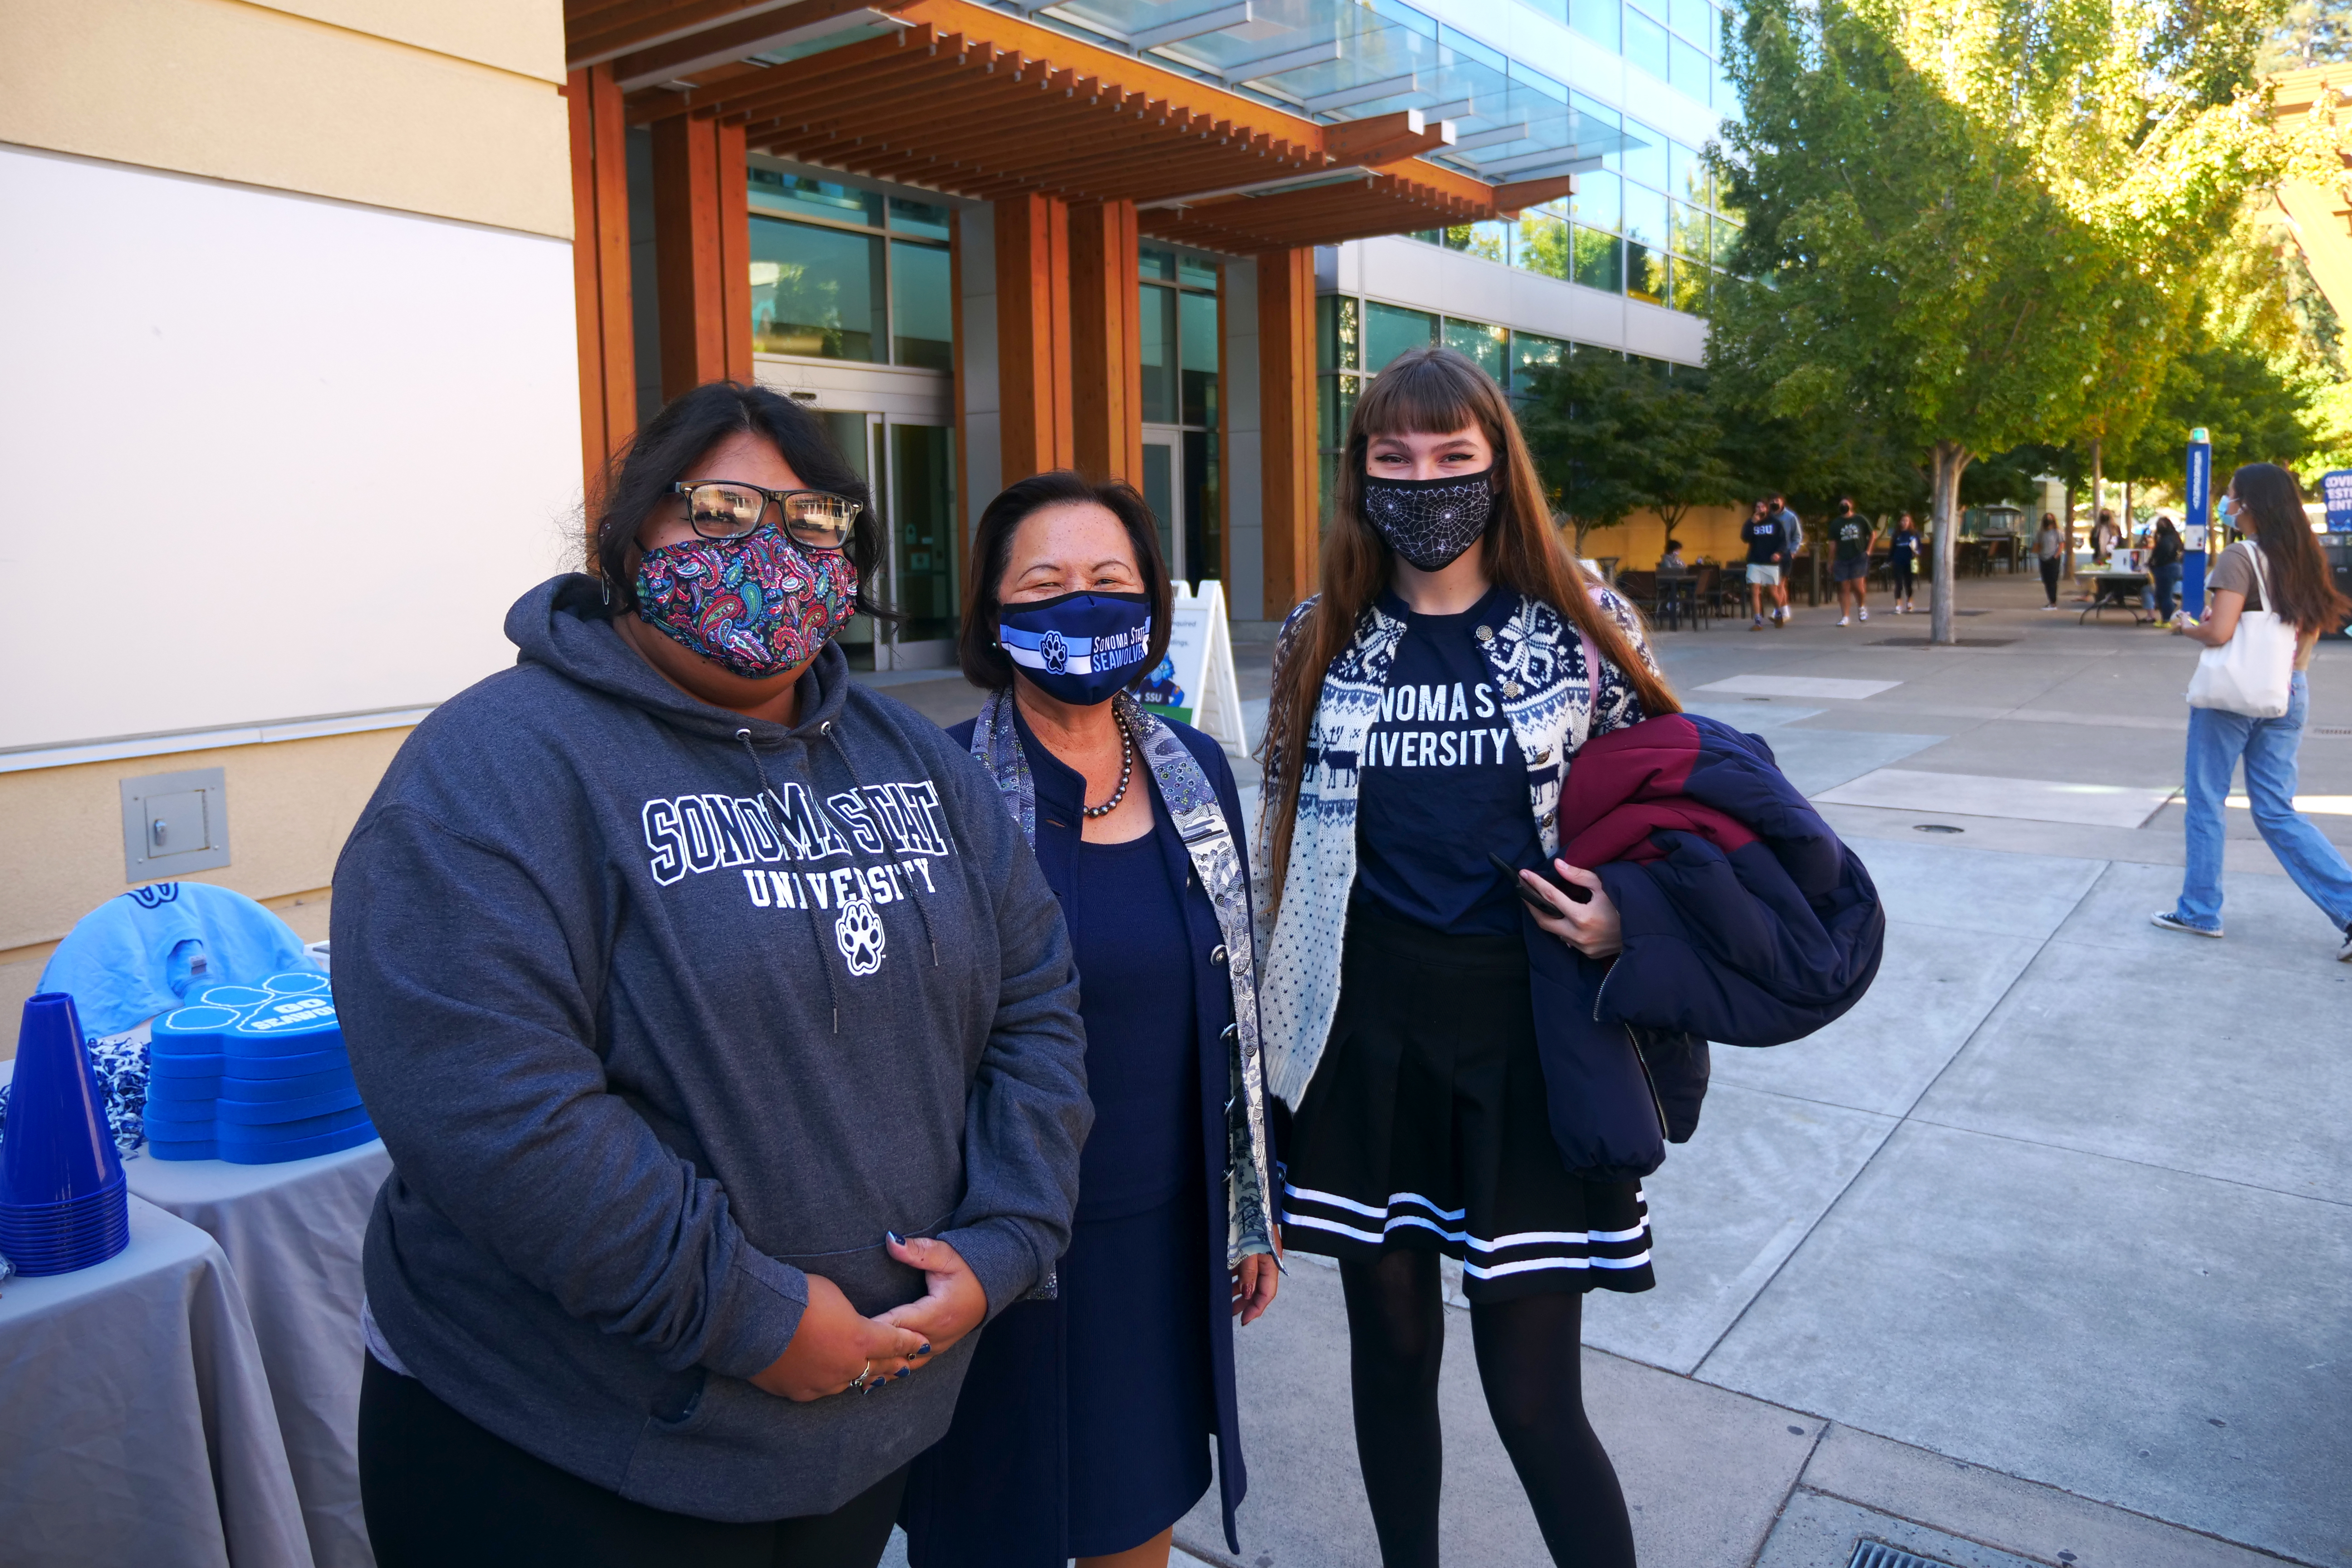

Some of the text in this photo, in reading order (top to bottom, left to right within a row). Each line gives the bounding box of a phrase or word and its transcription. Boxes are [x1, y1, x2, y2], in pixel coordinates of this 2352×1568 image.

[1754, 524, 1773, 534] SSU
[1093, 626, 1146, 653] SONOMA STATE
[1093, 643, 1144, 672] SEAWOLVES
[1144, 692, 1161, 702] SSU
[1375, 682, 1495, 722] NOMA S
[827, 780, 952, 856] STAT
[250, 1005, 336, 1030] SEAWOL
[273, 998, 327, 1014] GO
